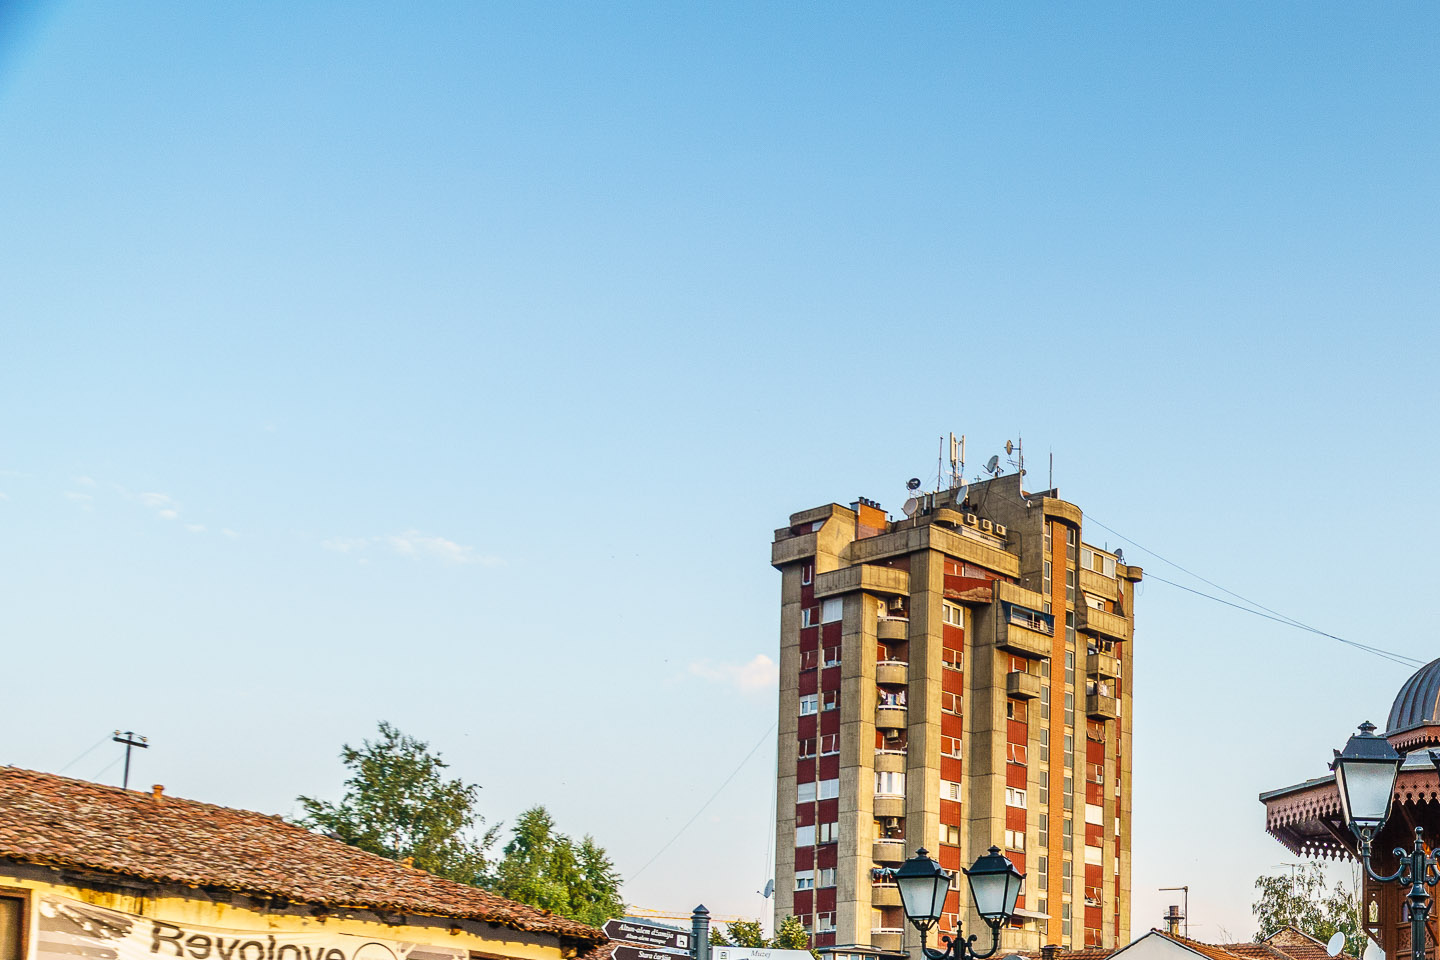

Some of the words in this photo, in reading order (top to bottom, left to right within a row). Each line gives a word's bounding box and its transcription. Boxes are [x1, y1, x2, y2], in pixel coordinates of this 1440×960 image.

[651, 927, 674, 940] džamija
[638, 950, 653, 959] Stara
[751, 950, 771, 959] Muzej
